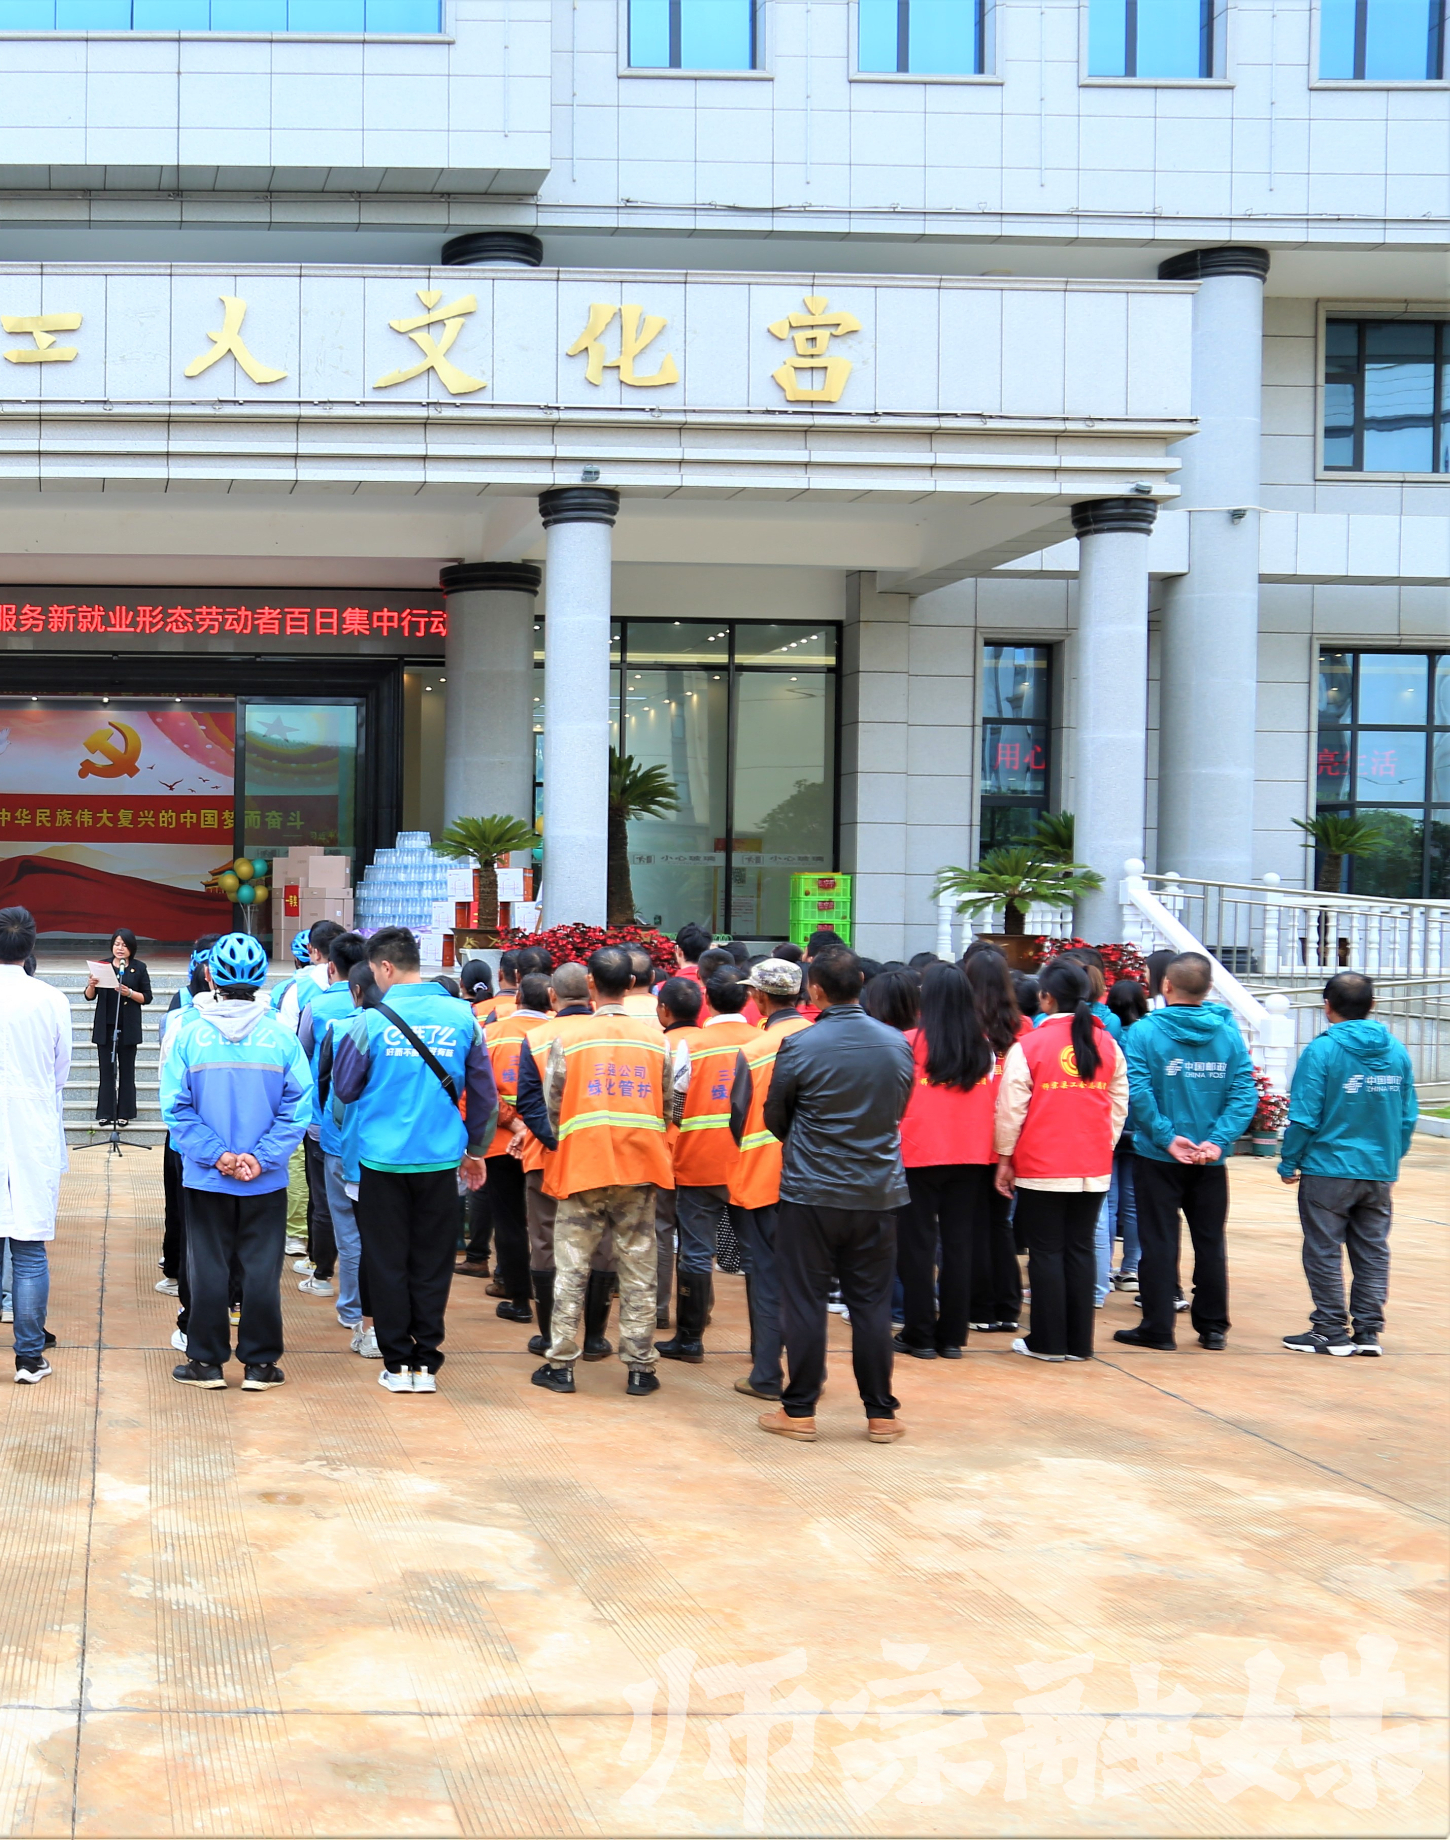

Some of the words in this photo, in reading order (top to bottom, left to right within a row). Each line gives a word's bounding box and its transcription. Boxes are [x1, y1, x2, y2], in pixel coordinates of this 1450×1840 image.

[993, 743, 1046, 770] 用心
[1184, 1061, 1227, 1072] 中国邮政
[588, 1078, 652, 1099] 绿化管护
